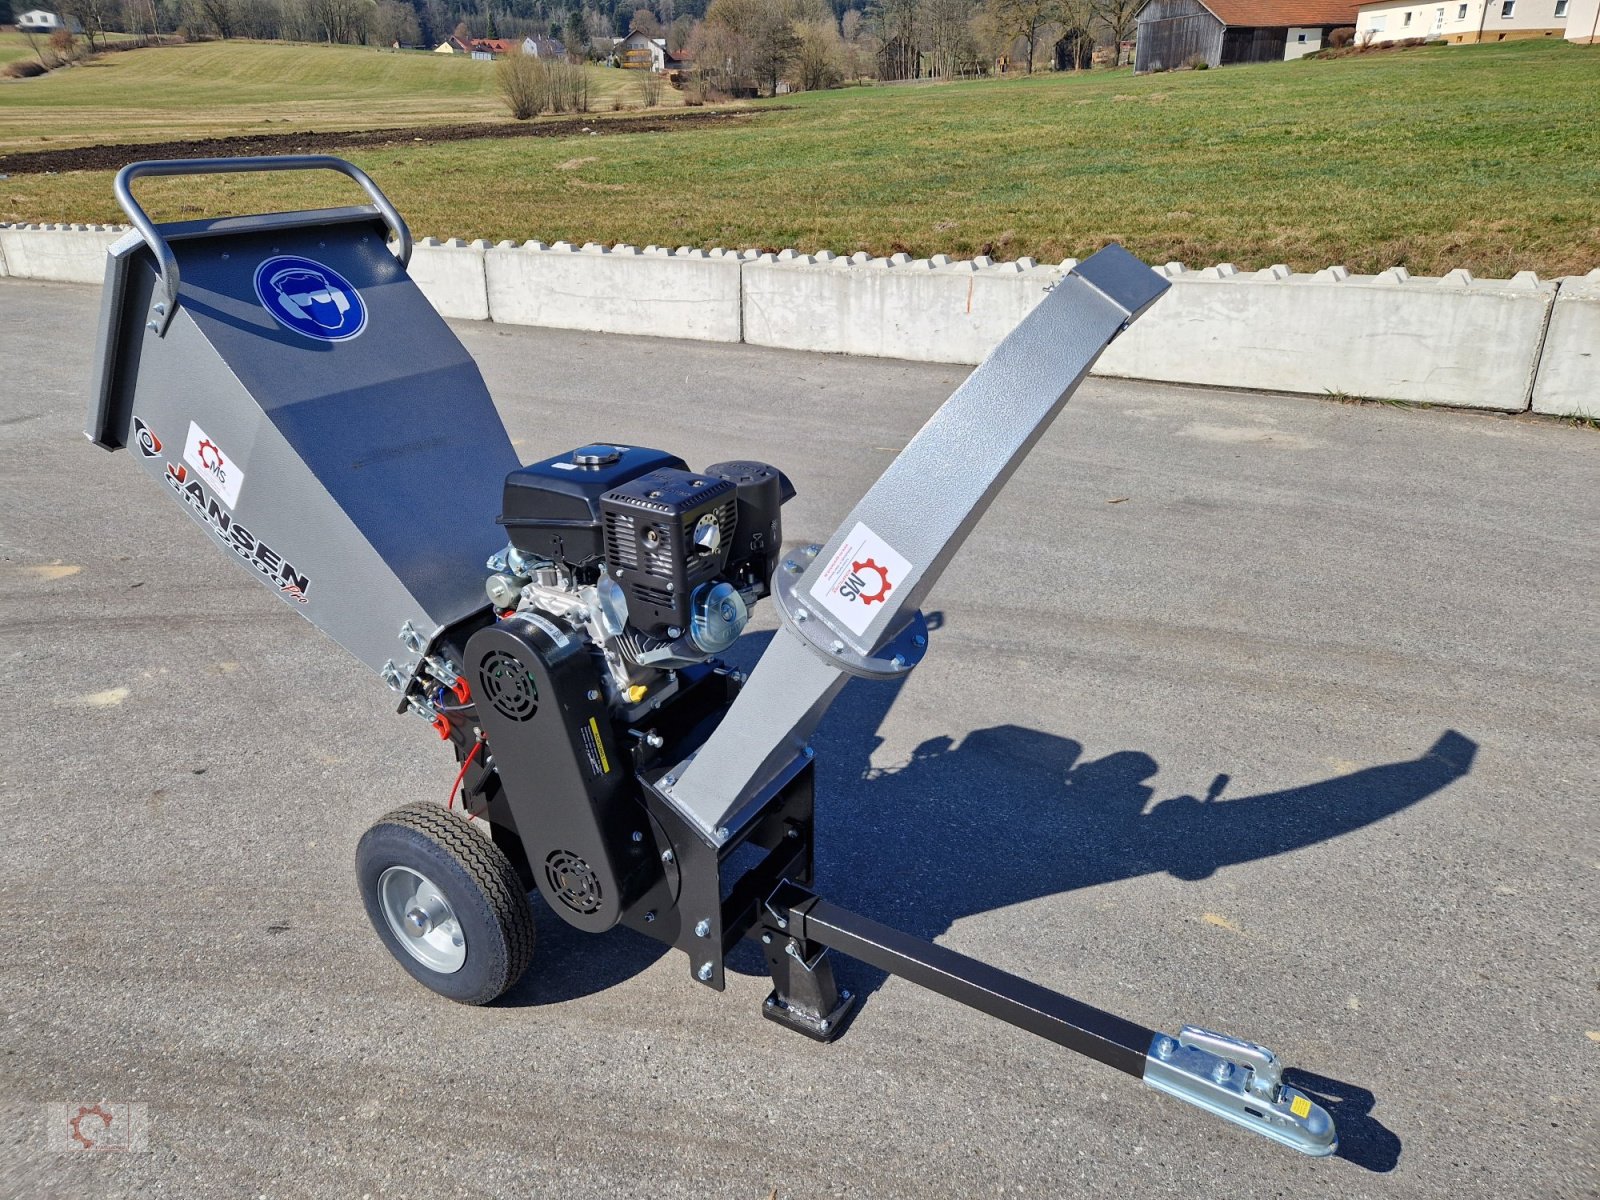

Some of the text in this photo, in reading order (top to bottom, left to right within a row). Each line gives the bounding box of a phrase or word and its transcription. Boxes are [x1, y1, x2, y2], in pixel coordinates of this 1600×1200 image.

[209, 460, 227, 484] MS
[167, 462, 310, 595] JANSEN
[281, 584, 309, 604] Pro
[839, 572, 866, 602] MS
